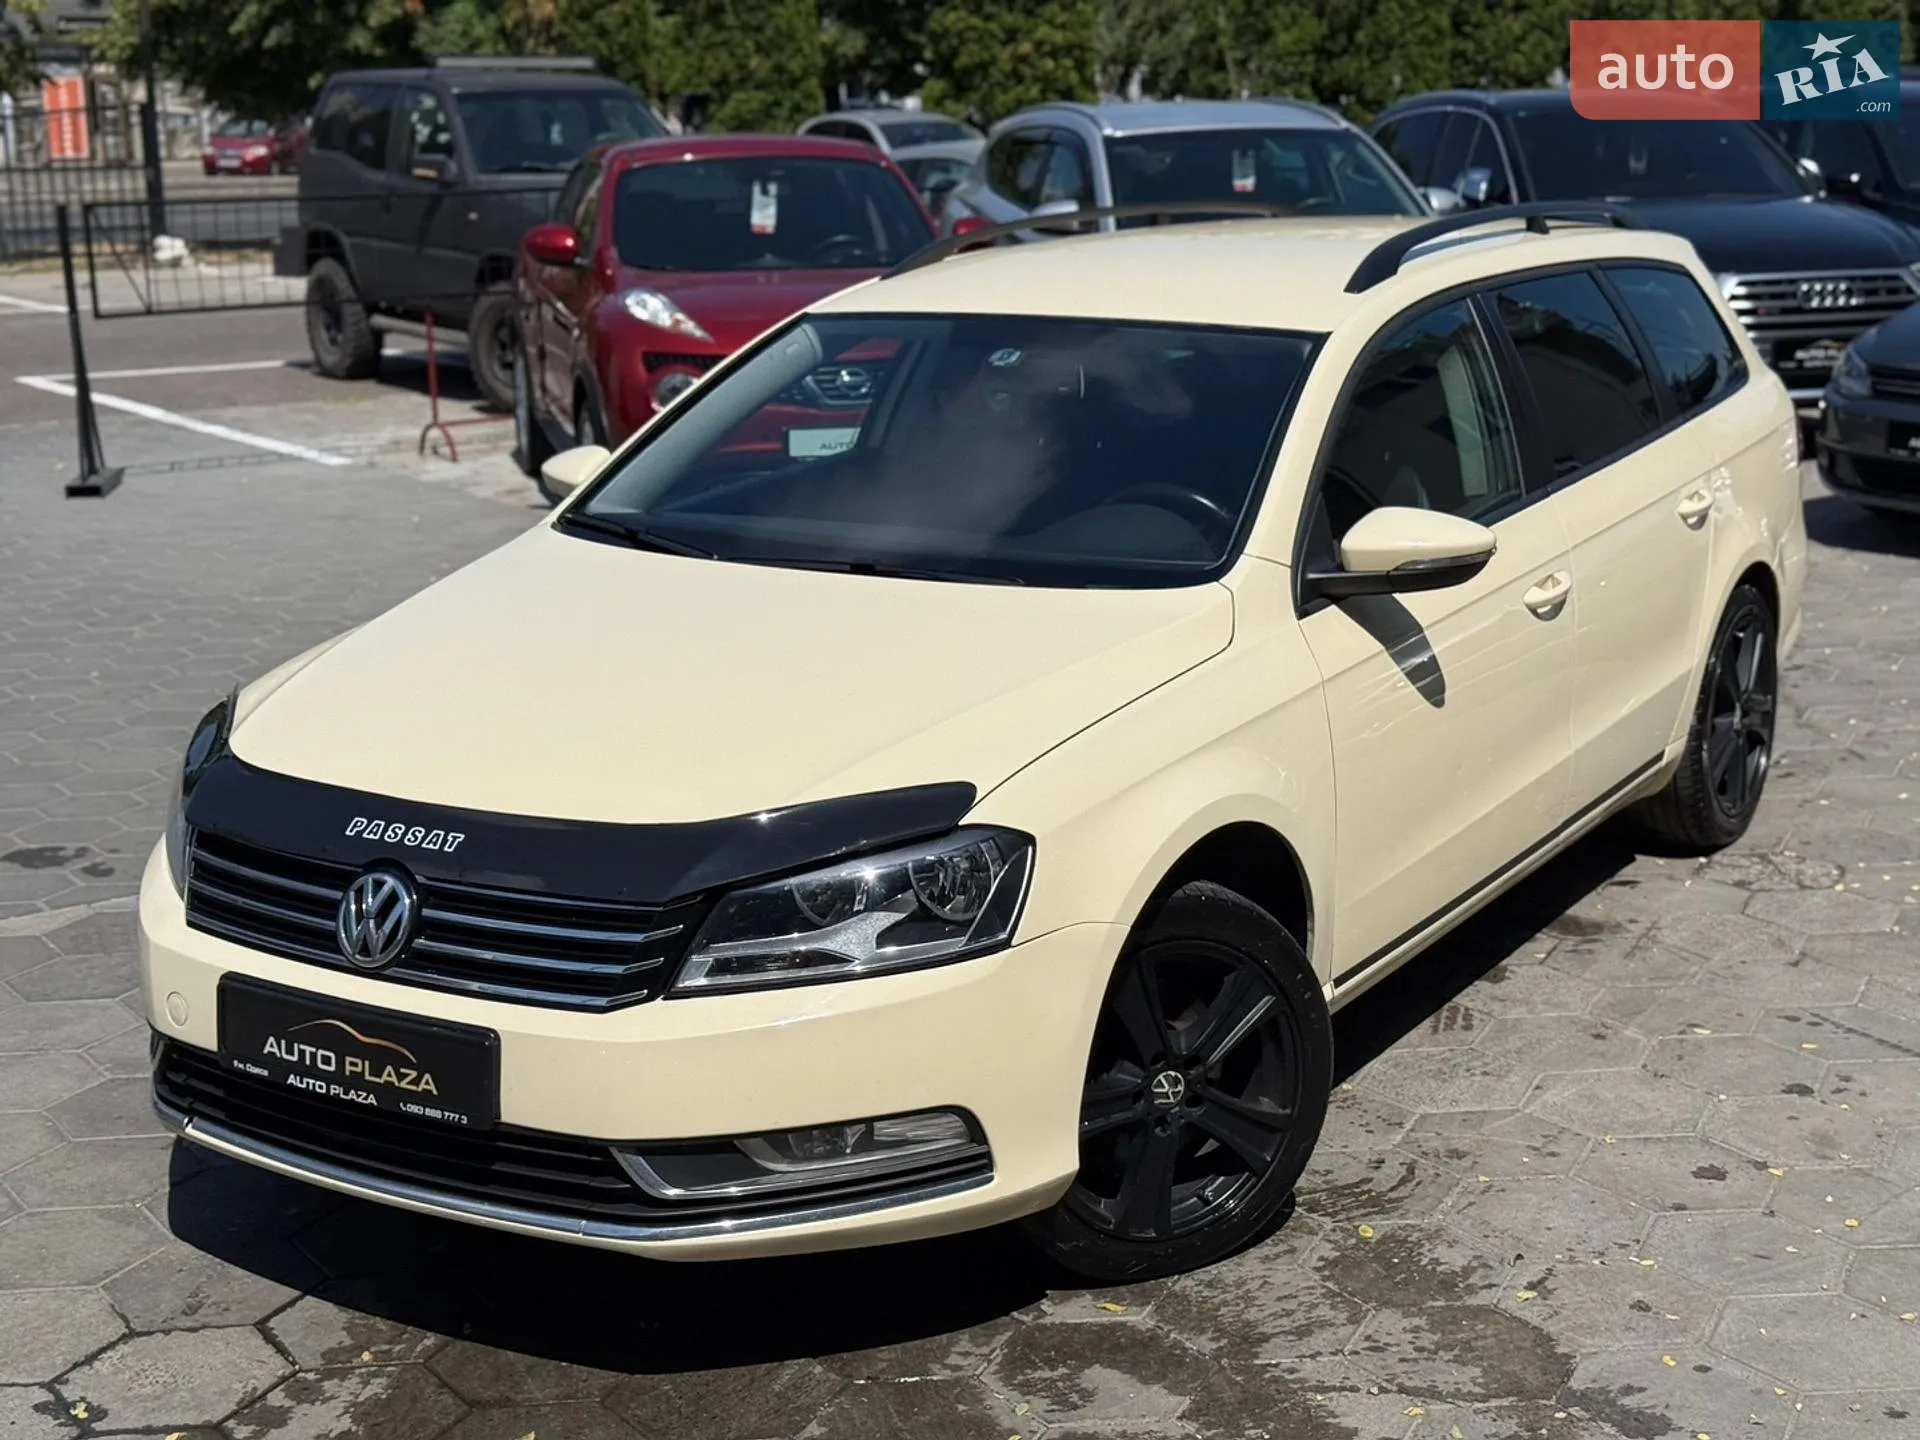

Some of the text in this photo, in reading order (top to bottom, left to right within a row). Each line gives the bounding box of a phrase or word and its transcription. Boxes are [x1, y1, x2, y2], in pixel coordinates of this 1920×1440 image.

[345, 817, 465, 852] PASSAT
[263, 1036, 438, 1096] AUTO PLAZA
[286, 1073, 378, 1106] AUTO PLAZA
[443, 1111, 460, 1122] 777
[460, 1115, 468, 1125] 3
